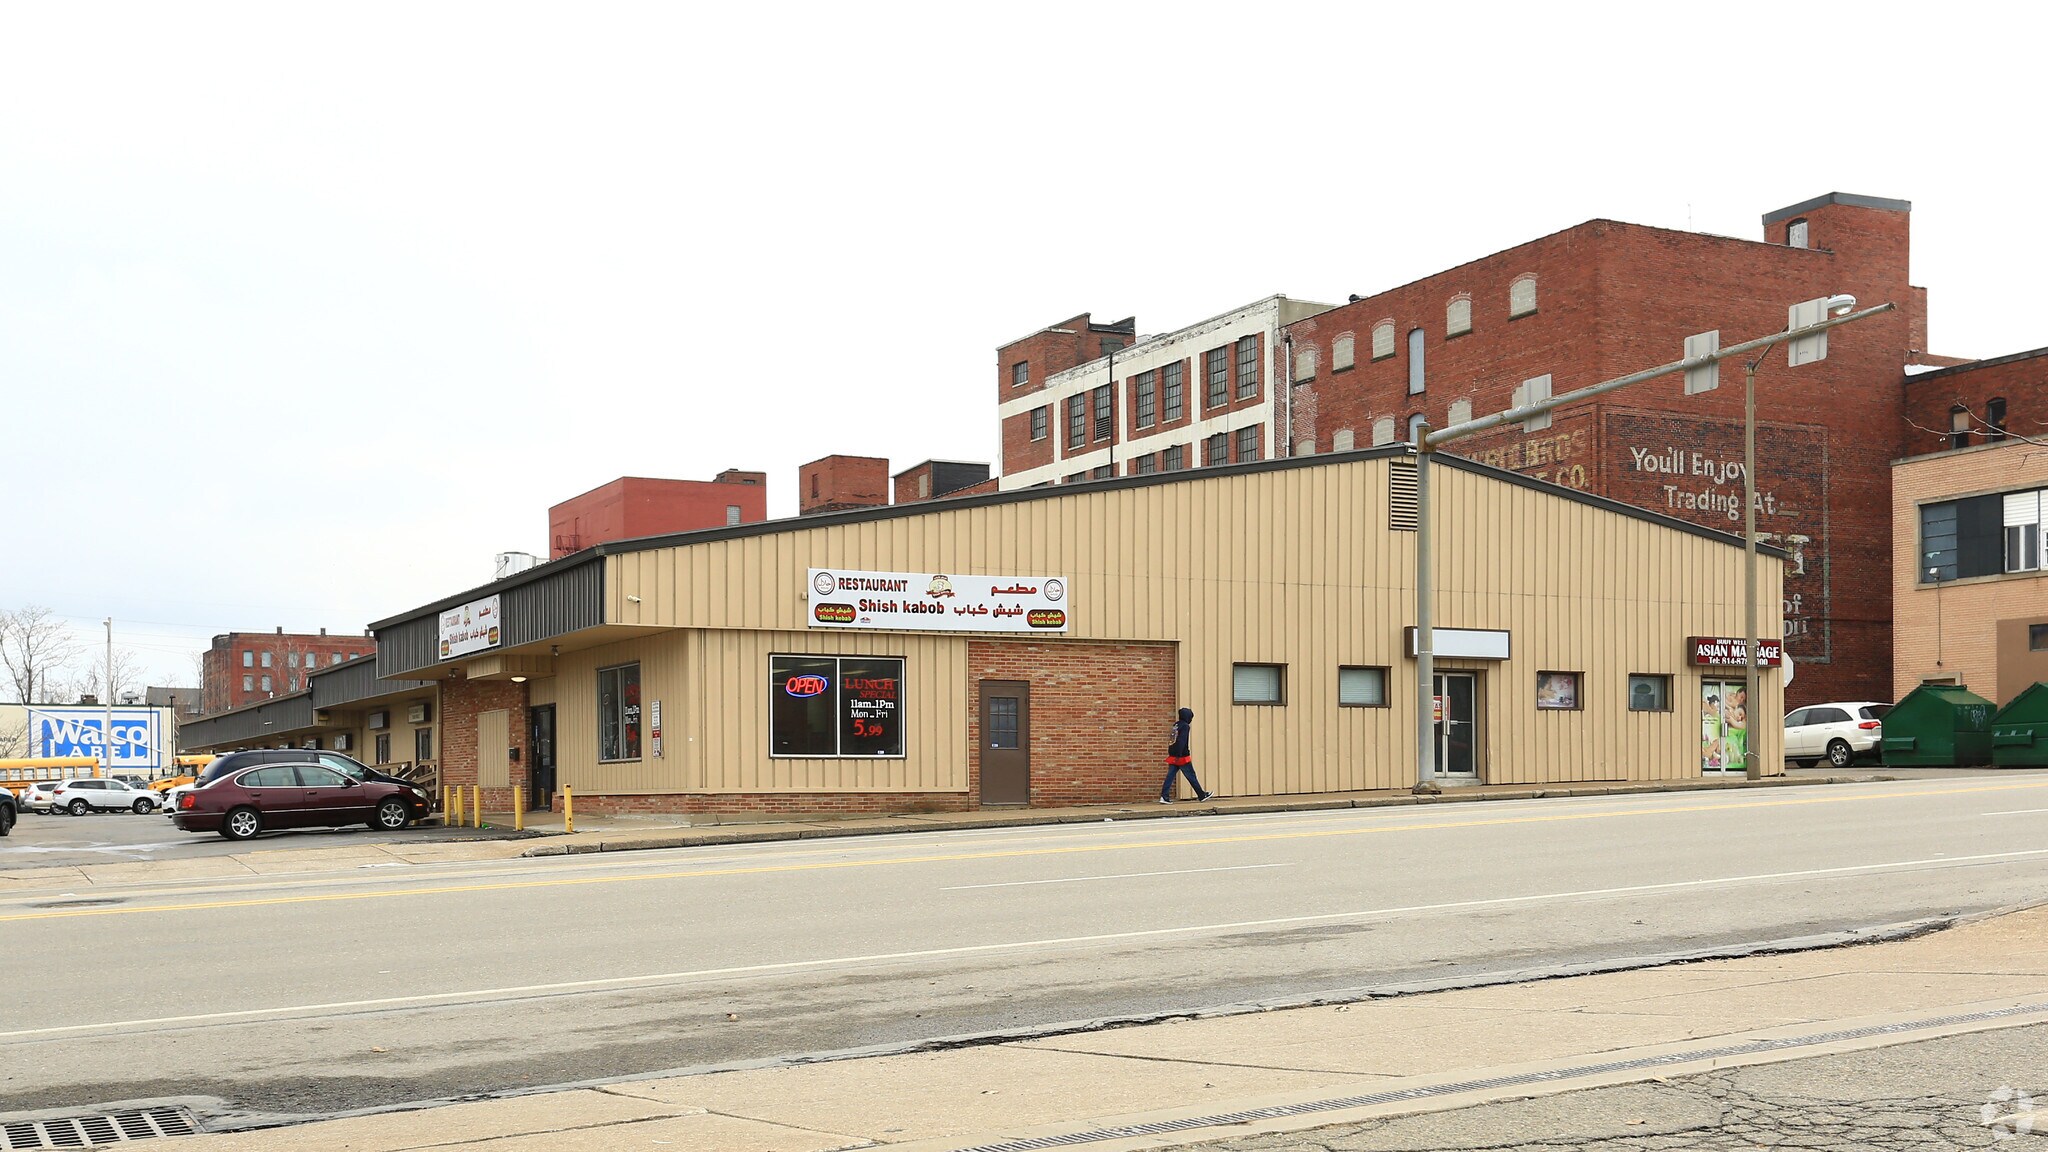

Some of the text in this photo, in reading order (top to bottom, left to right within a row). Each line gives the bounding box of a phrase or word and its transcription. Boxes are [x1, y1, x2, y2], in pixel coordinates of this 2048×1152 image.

[1630, 447, 1747, 486] You'll Enjoy
[1664, 485, 1739, 520] Trading
[838, 577, 908, 592] RESTAURANT
[991, 583, 1037, 596] مطعم
[859, 598, 945, 614] Shish kabob
[954, 603, 1024, 618] شيش كباب
[1697, 644, 1780, 659] ASIAN MAAGE
[786, 677, 824, 695] OPEN
[845, 678, 895, 690] LUNCH
[860, 690, 897, 699] SPECIAL
[850, 709, 869, 718] Mon
[876, 709, 888, 718] Fri
[46, 718, 149, 745] Walco
[49, 737, 147, 759] LABEL
